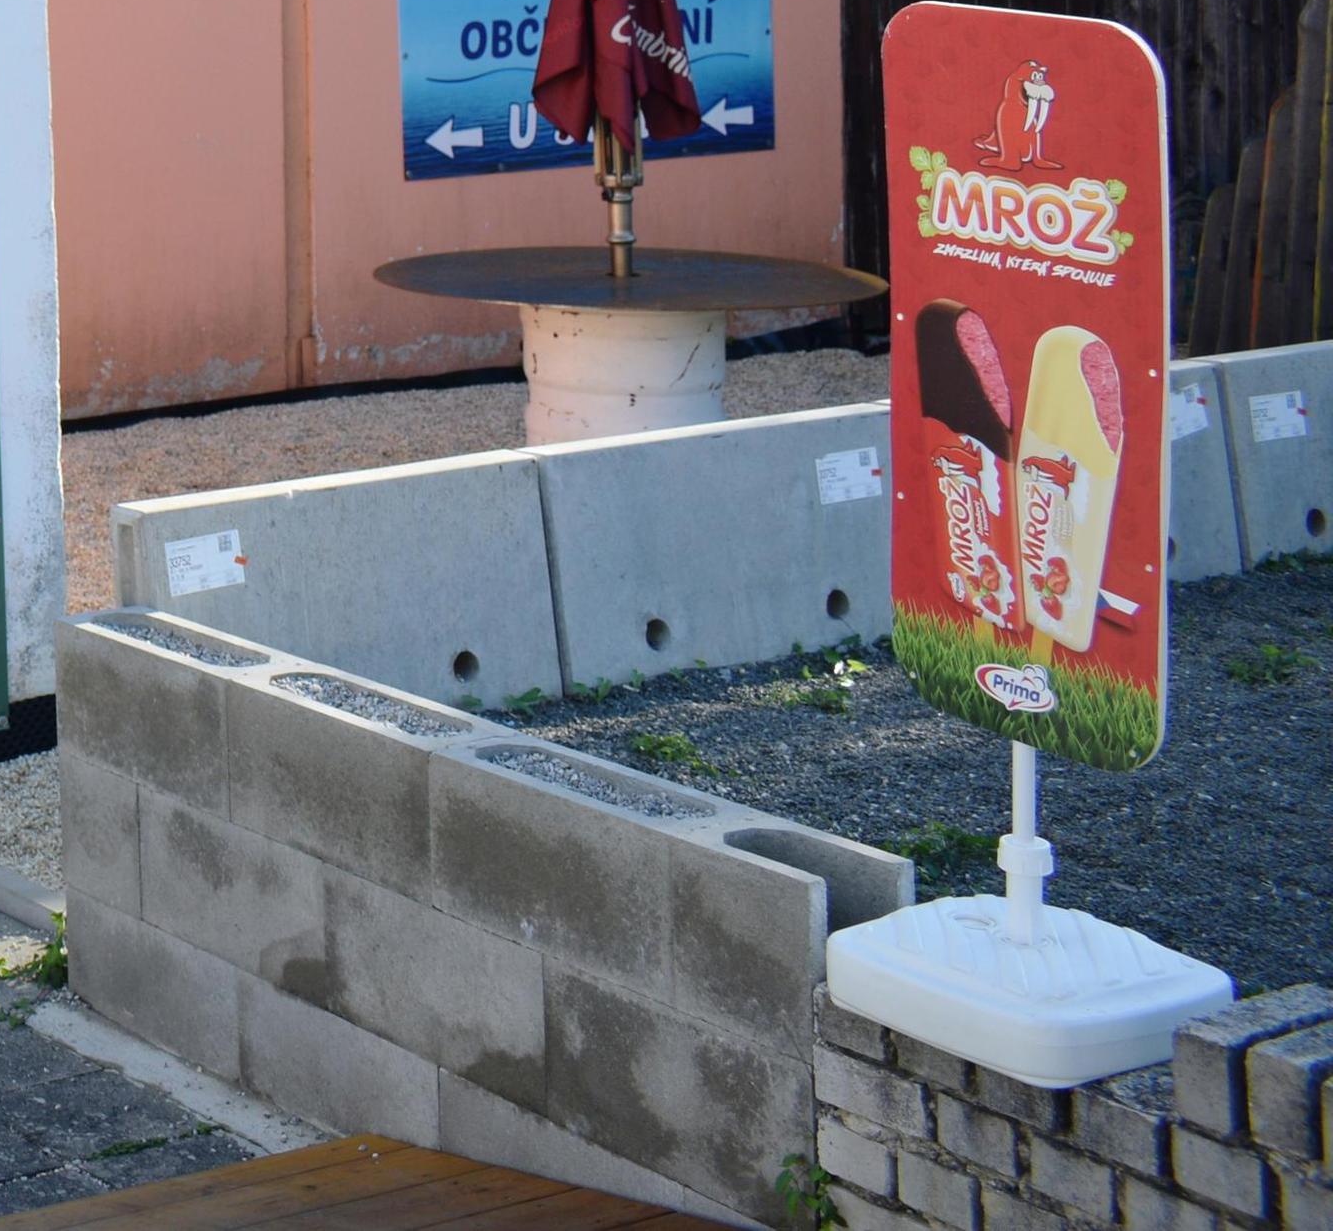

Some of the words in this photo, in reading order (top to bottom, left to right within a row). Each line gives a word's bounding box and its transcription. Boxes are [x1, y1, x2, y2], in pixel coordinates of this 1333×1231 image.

[508, 102, 538, 150] U
[936, 172, 1117, 259] MROŽ
[1006, 255, 1051, 277] KTERÁ
[1052, 264, 1116, 287] SPOJUJE
[942, 477, 975, 572] MROŽ
[1021, 483, 1052, 572] MROŽ
[994, 673, 1041, 703] Prima
